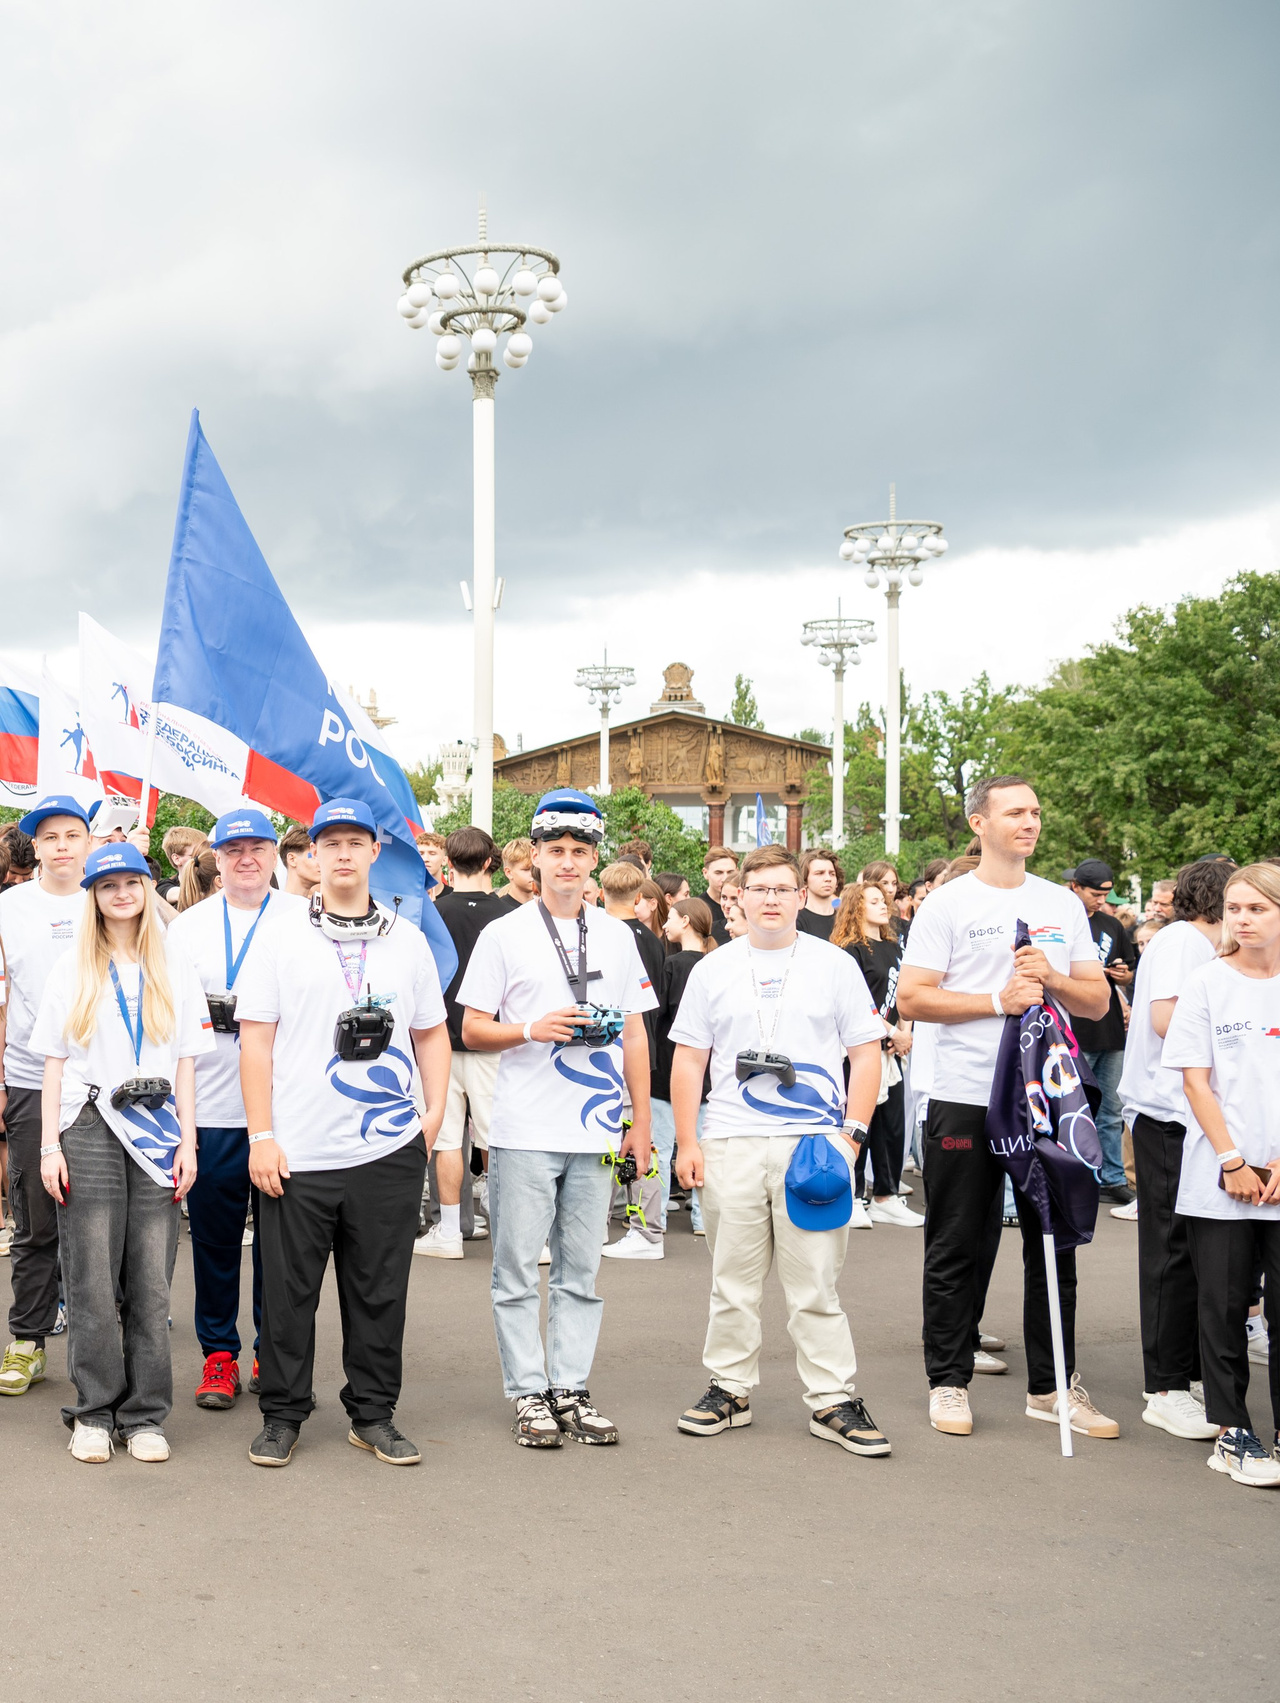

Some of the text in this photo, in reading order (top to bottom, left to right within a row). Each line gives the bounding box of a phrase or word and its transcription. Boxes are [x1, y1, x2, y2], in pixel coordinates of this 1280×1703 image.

[968, 925, 1004, 939] ВФФС
[1215, 1020, 1253, 1036] ВФФС
[988, 1134, 1034, 1158] ЦИЯ
